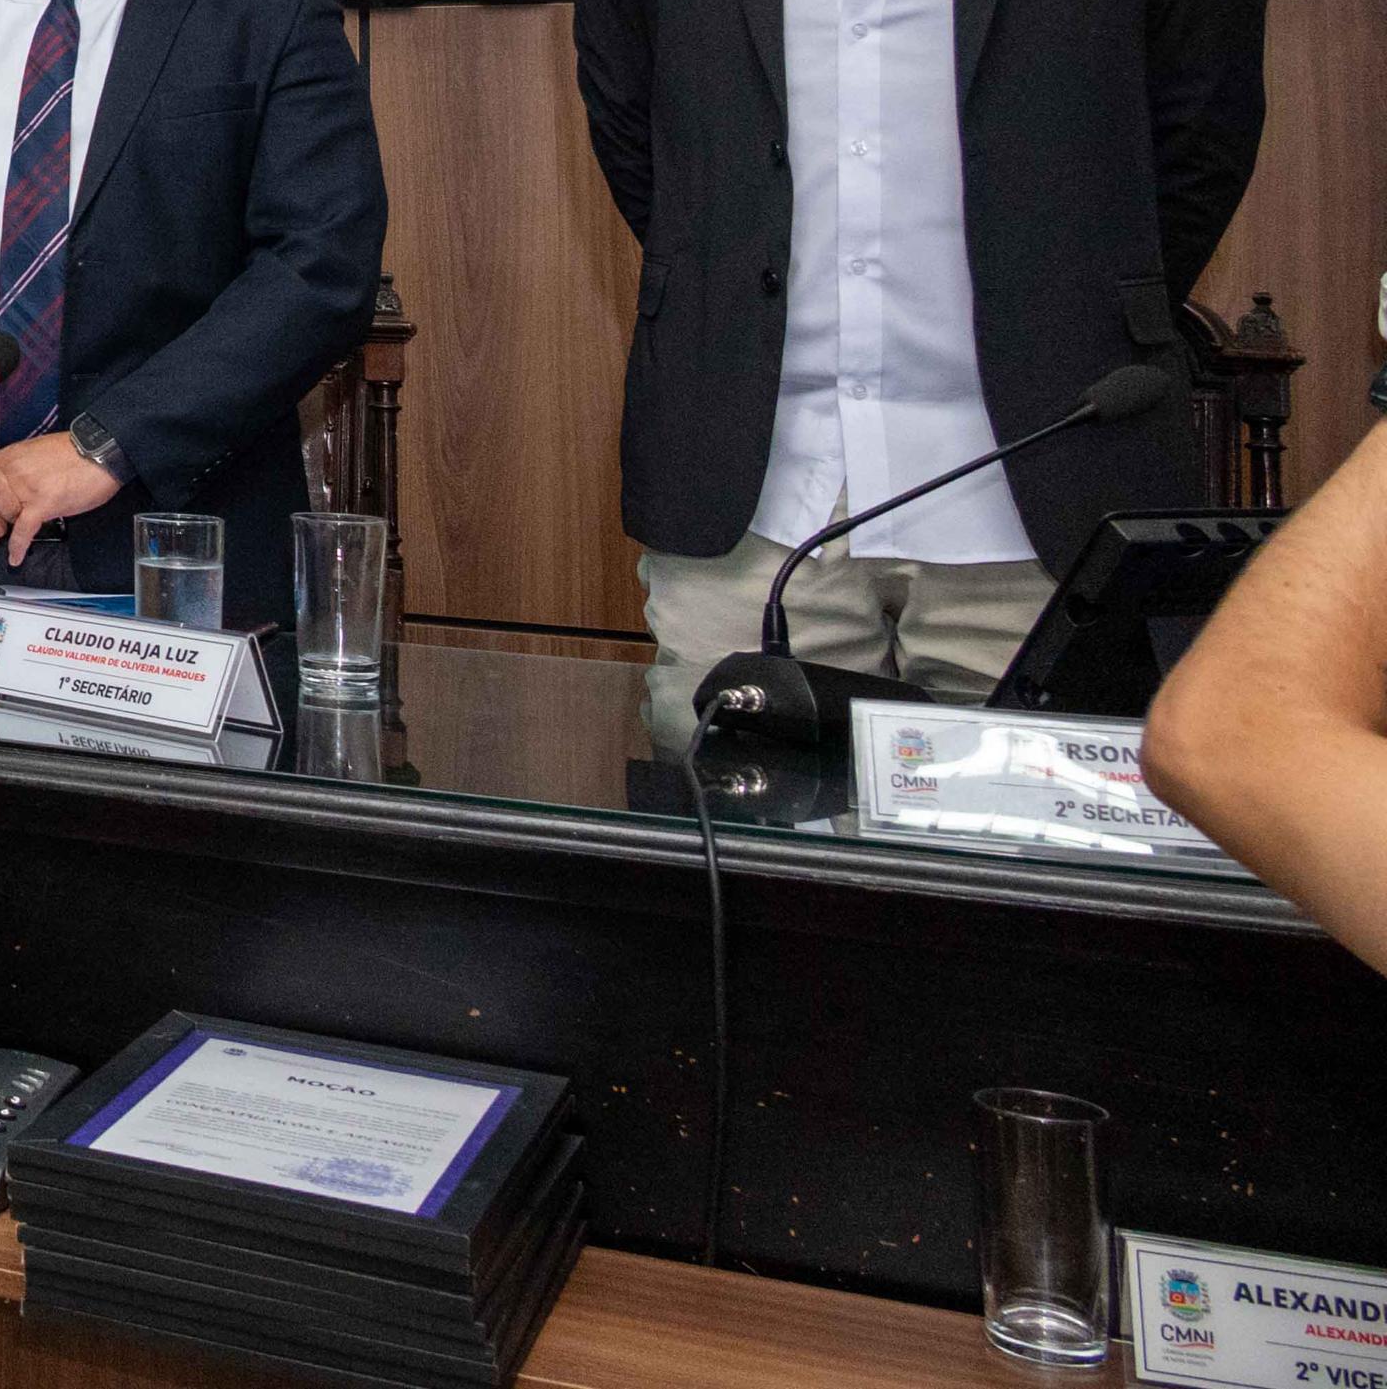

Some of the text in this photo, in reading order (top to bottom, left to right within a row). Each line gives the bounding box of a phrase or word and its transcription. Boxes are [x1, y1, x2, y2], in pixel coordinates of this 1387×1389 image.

[45, 627, 199, 665] CLAUDIO HAJA LUZ
[27, 644, 206, 683] CLAUDIO VALDEMIR DE OLIVEIRA MARQUES
[71, 679, 152, 706] SECRETÁRIO
[891, 774, 938, 789] CMNI
[287, 1075, 376, 1097] MOÇÃO
[1233, 1282, 1387, 1324] ALEXAND
[1161, 1323, 1215, 1345] CMNI
